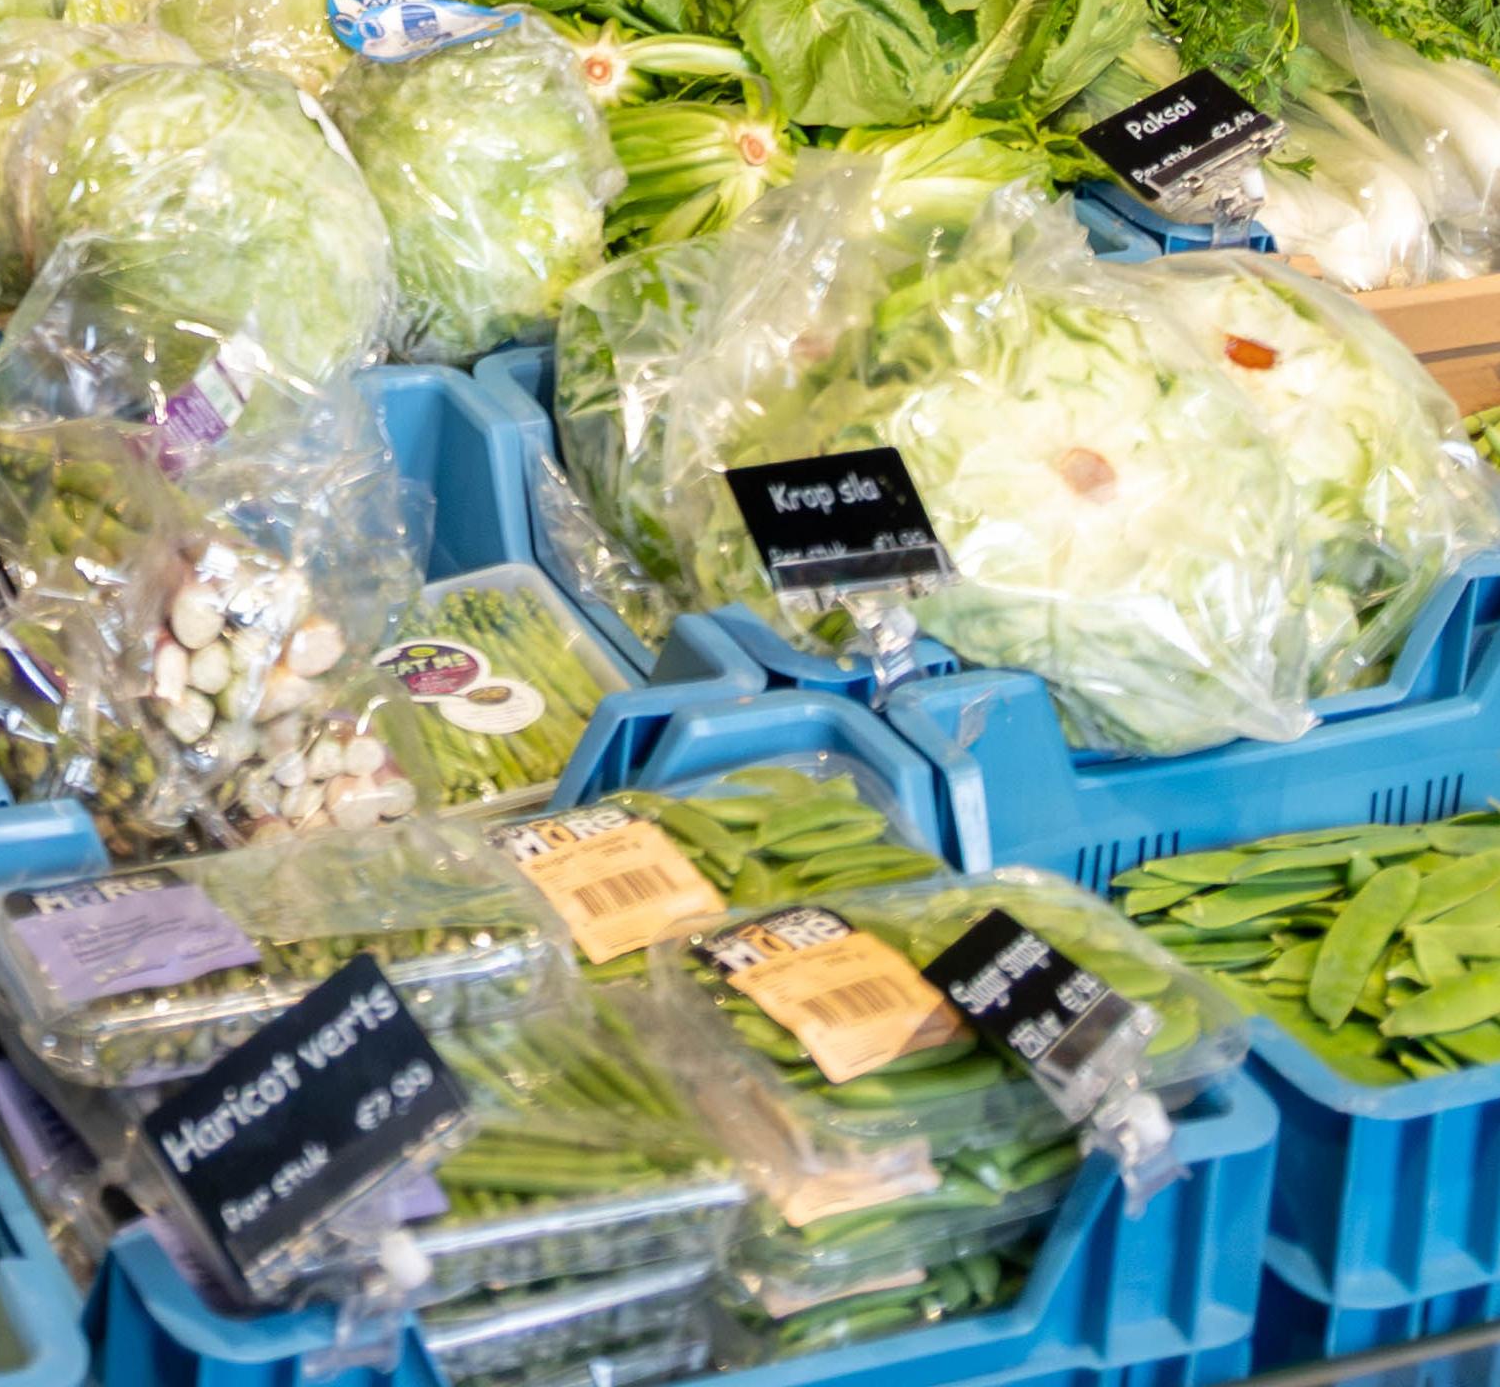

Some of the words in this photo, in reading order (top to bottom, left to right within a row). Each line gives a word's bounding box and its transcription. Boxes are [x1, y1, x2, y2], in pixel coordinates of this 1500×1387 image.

[1124, 94, 1197, 141] Paksoi
[767, 480, 835, 516] Krop
[838, 470, 882, 505] sla
[160, 1051, 301, 1173] Haricot
[297, 981, 399, 1070] verts
